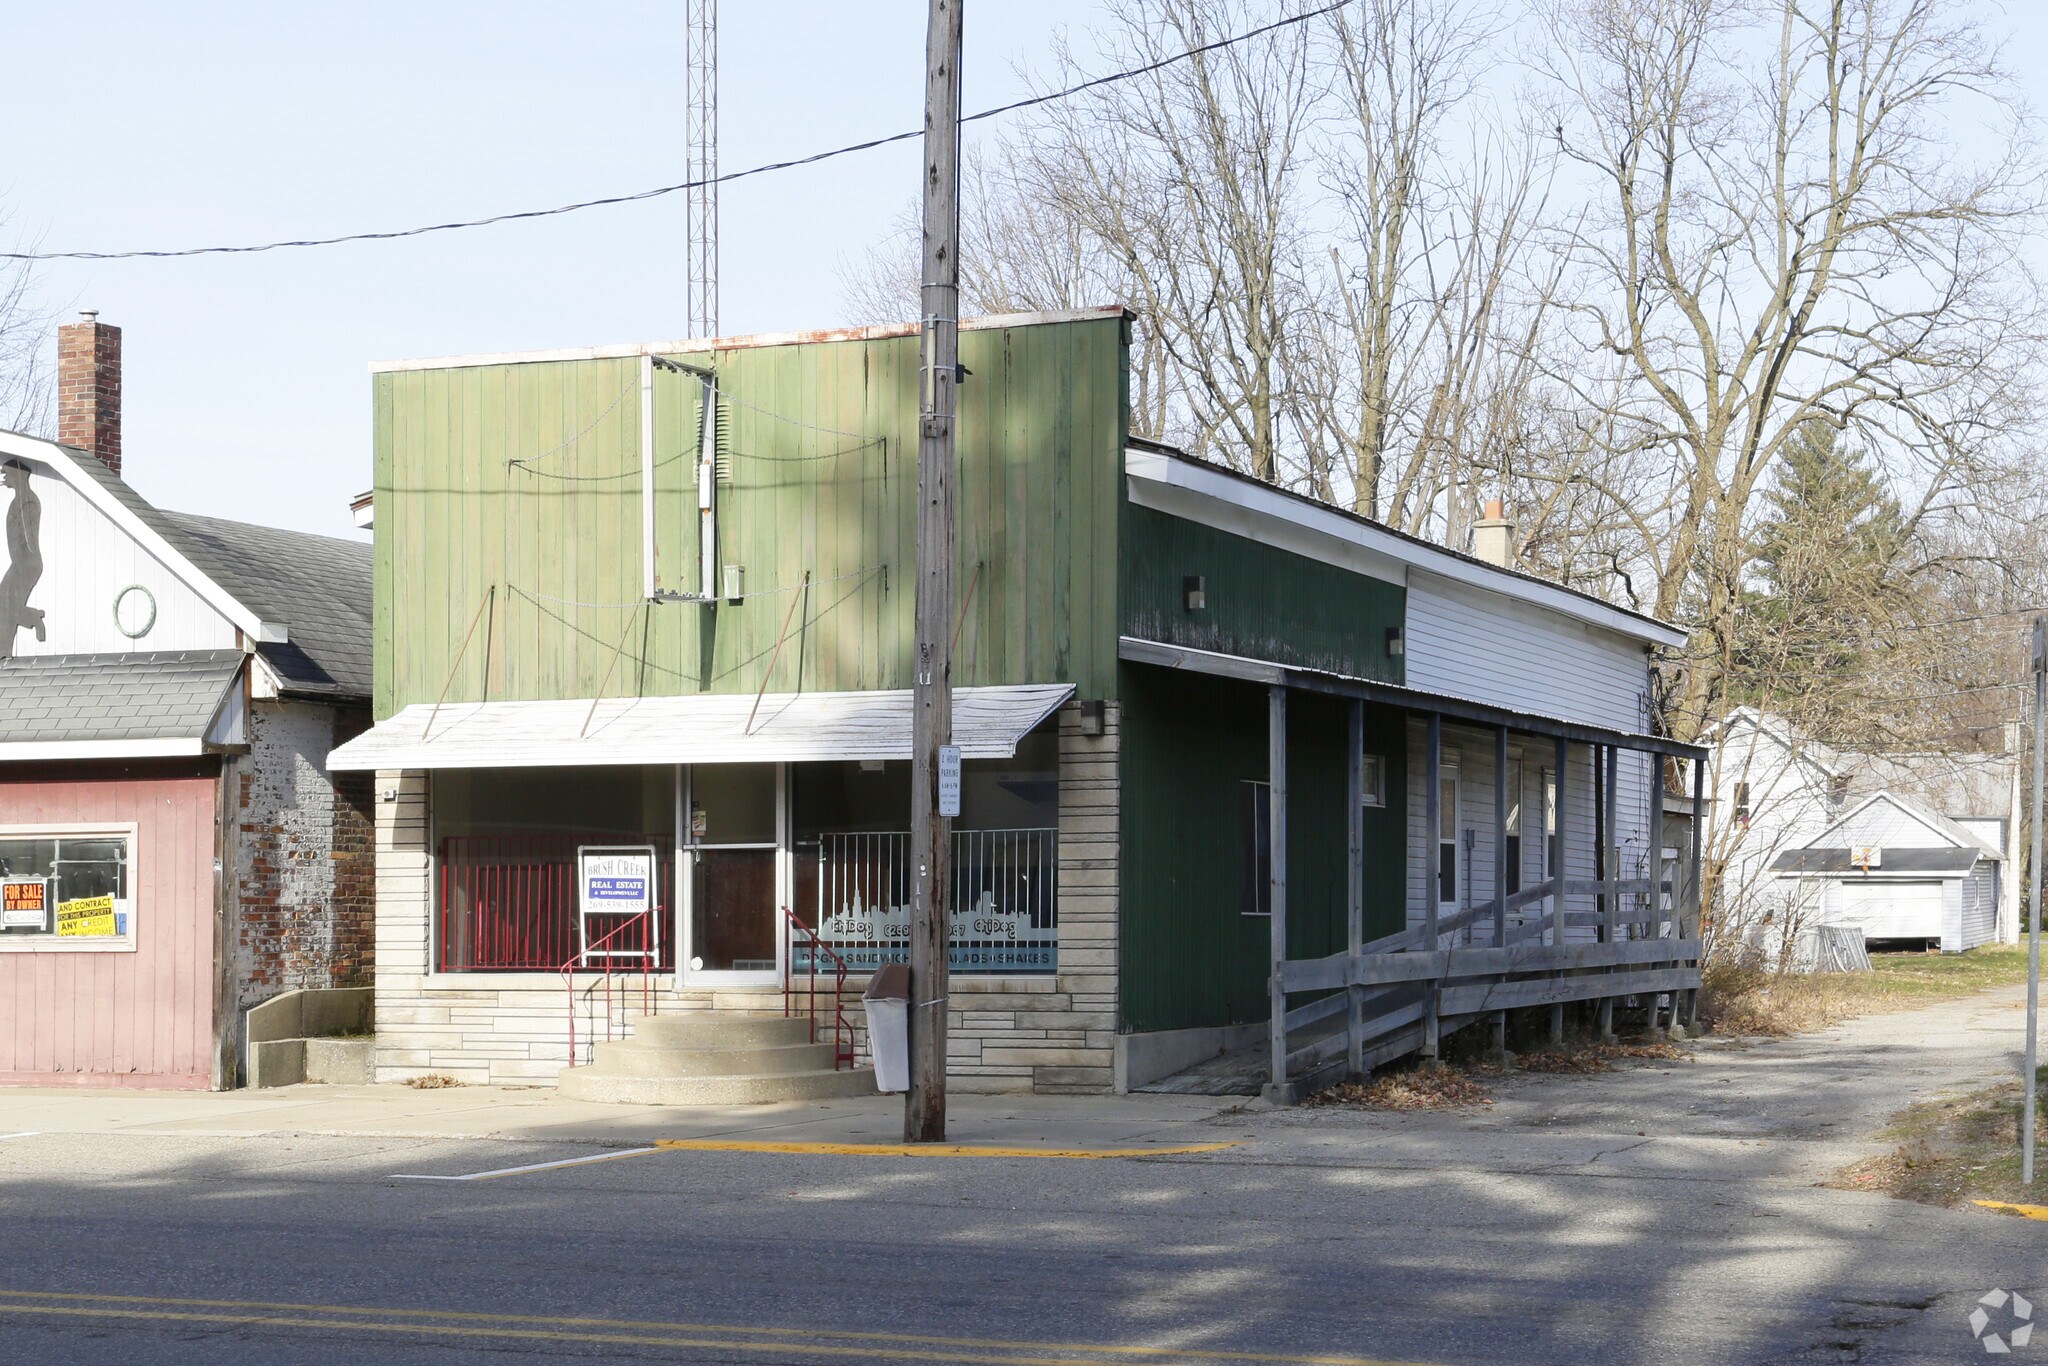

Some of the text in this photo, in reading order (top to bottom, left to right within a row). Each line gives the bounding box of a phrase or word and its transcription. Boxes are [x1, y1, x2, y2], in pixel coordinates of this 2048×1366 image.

[946, 754, 958, 763] HOUR
[941, 769, 958, 777] PARKING
[588, 859, 647, 876] BRUSH CREEK
[591, 881, 643, 889] REAL ESTATE
[4, 884, 43, 900] FOR SALE
[6, 899, 42, 910] BY OWNER
[57, 898, 111, 913] AND CONTRACT
[82, 908, 111, 917] PROPERTY
[61, 921, 78, 931] ANY
[974, 919, 1016, 940] ChiDog
[998, 953, 1050, 964] SHAKES
